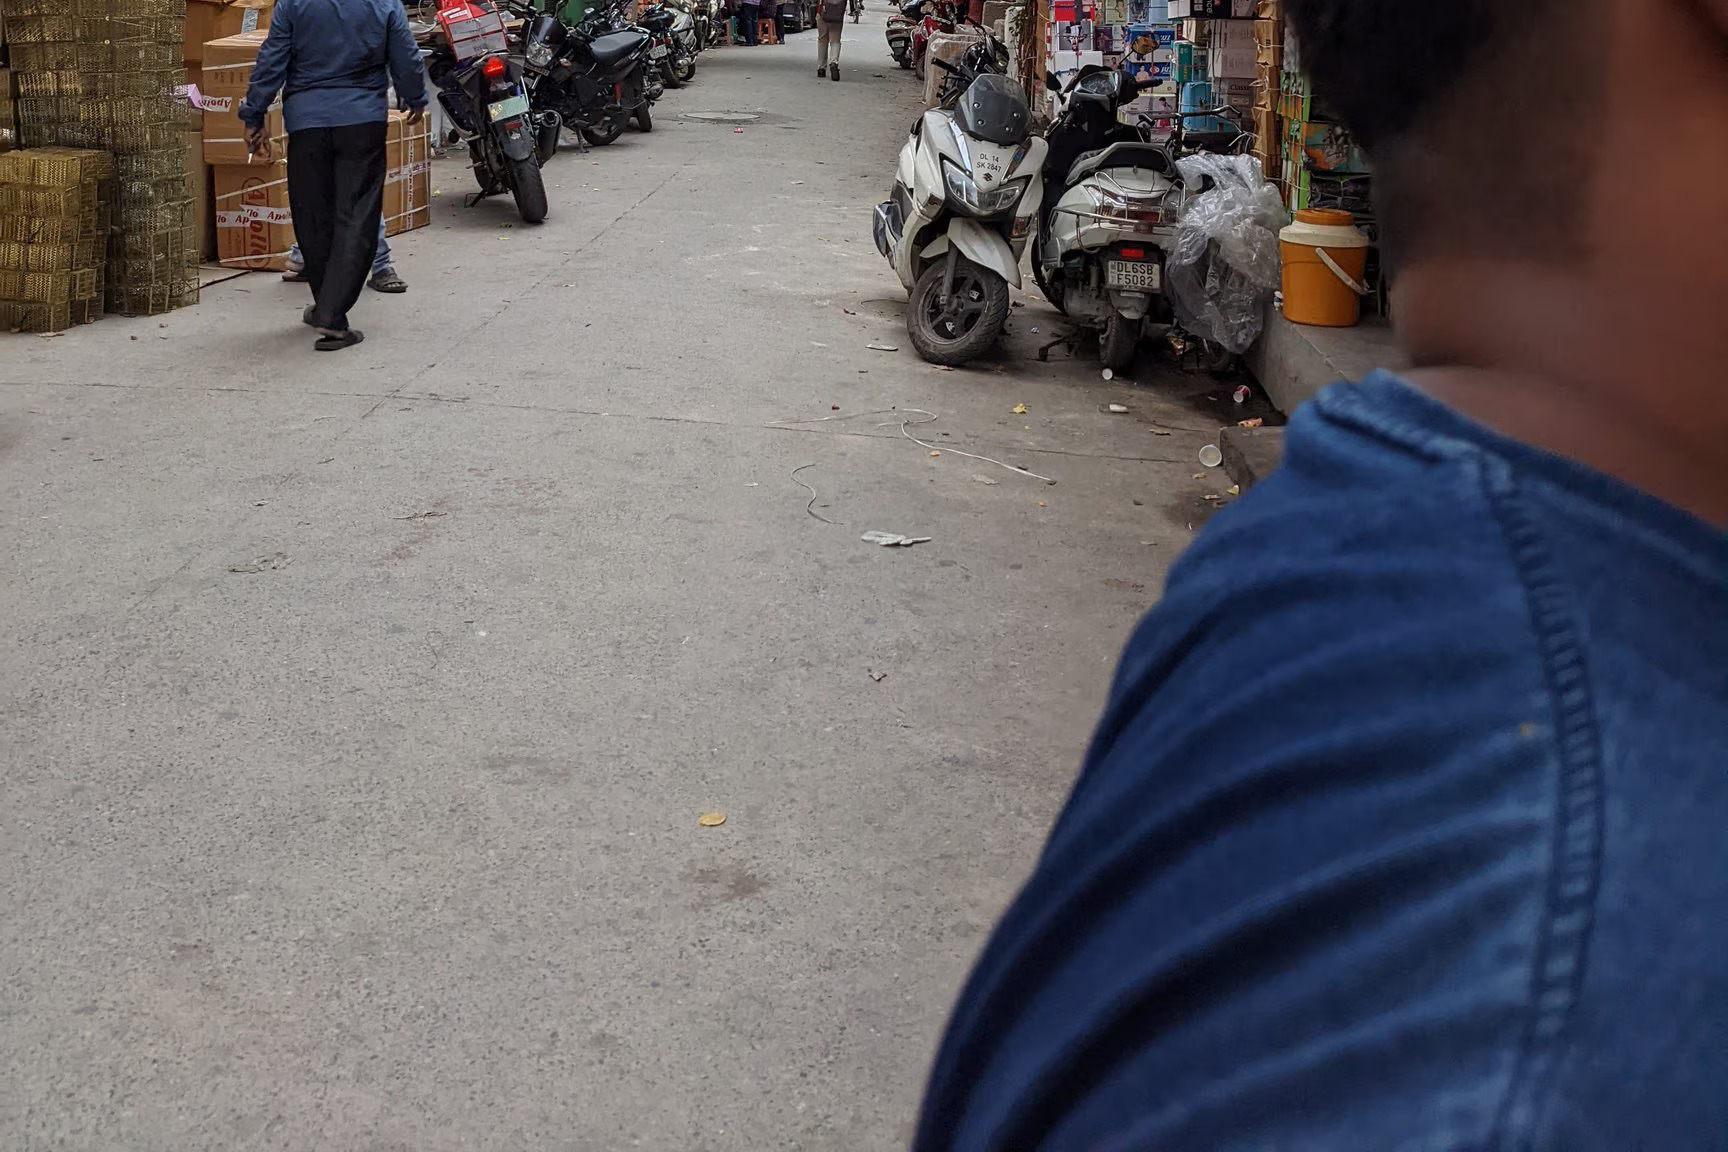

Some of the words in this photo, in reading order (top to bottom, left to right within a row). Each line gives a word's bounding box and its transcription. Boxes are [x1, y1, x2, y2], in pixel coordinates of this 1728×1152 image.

[979, 152, 989, 160] DL
[992, 155, 999, 163] 14
[976, 161, 986, 169] SK
[986, 162, 1002, 173] 2847
[1116, 262, 1154, 275] DL6SB
[1116, 273, 1154, 287] F5082
